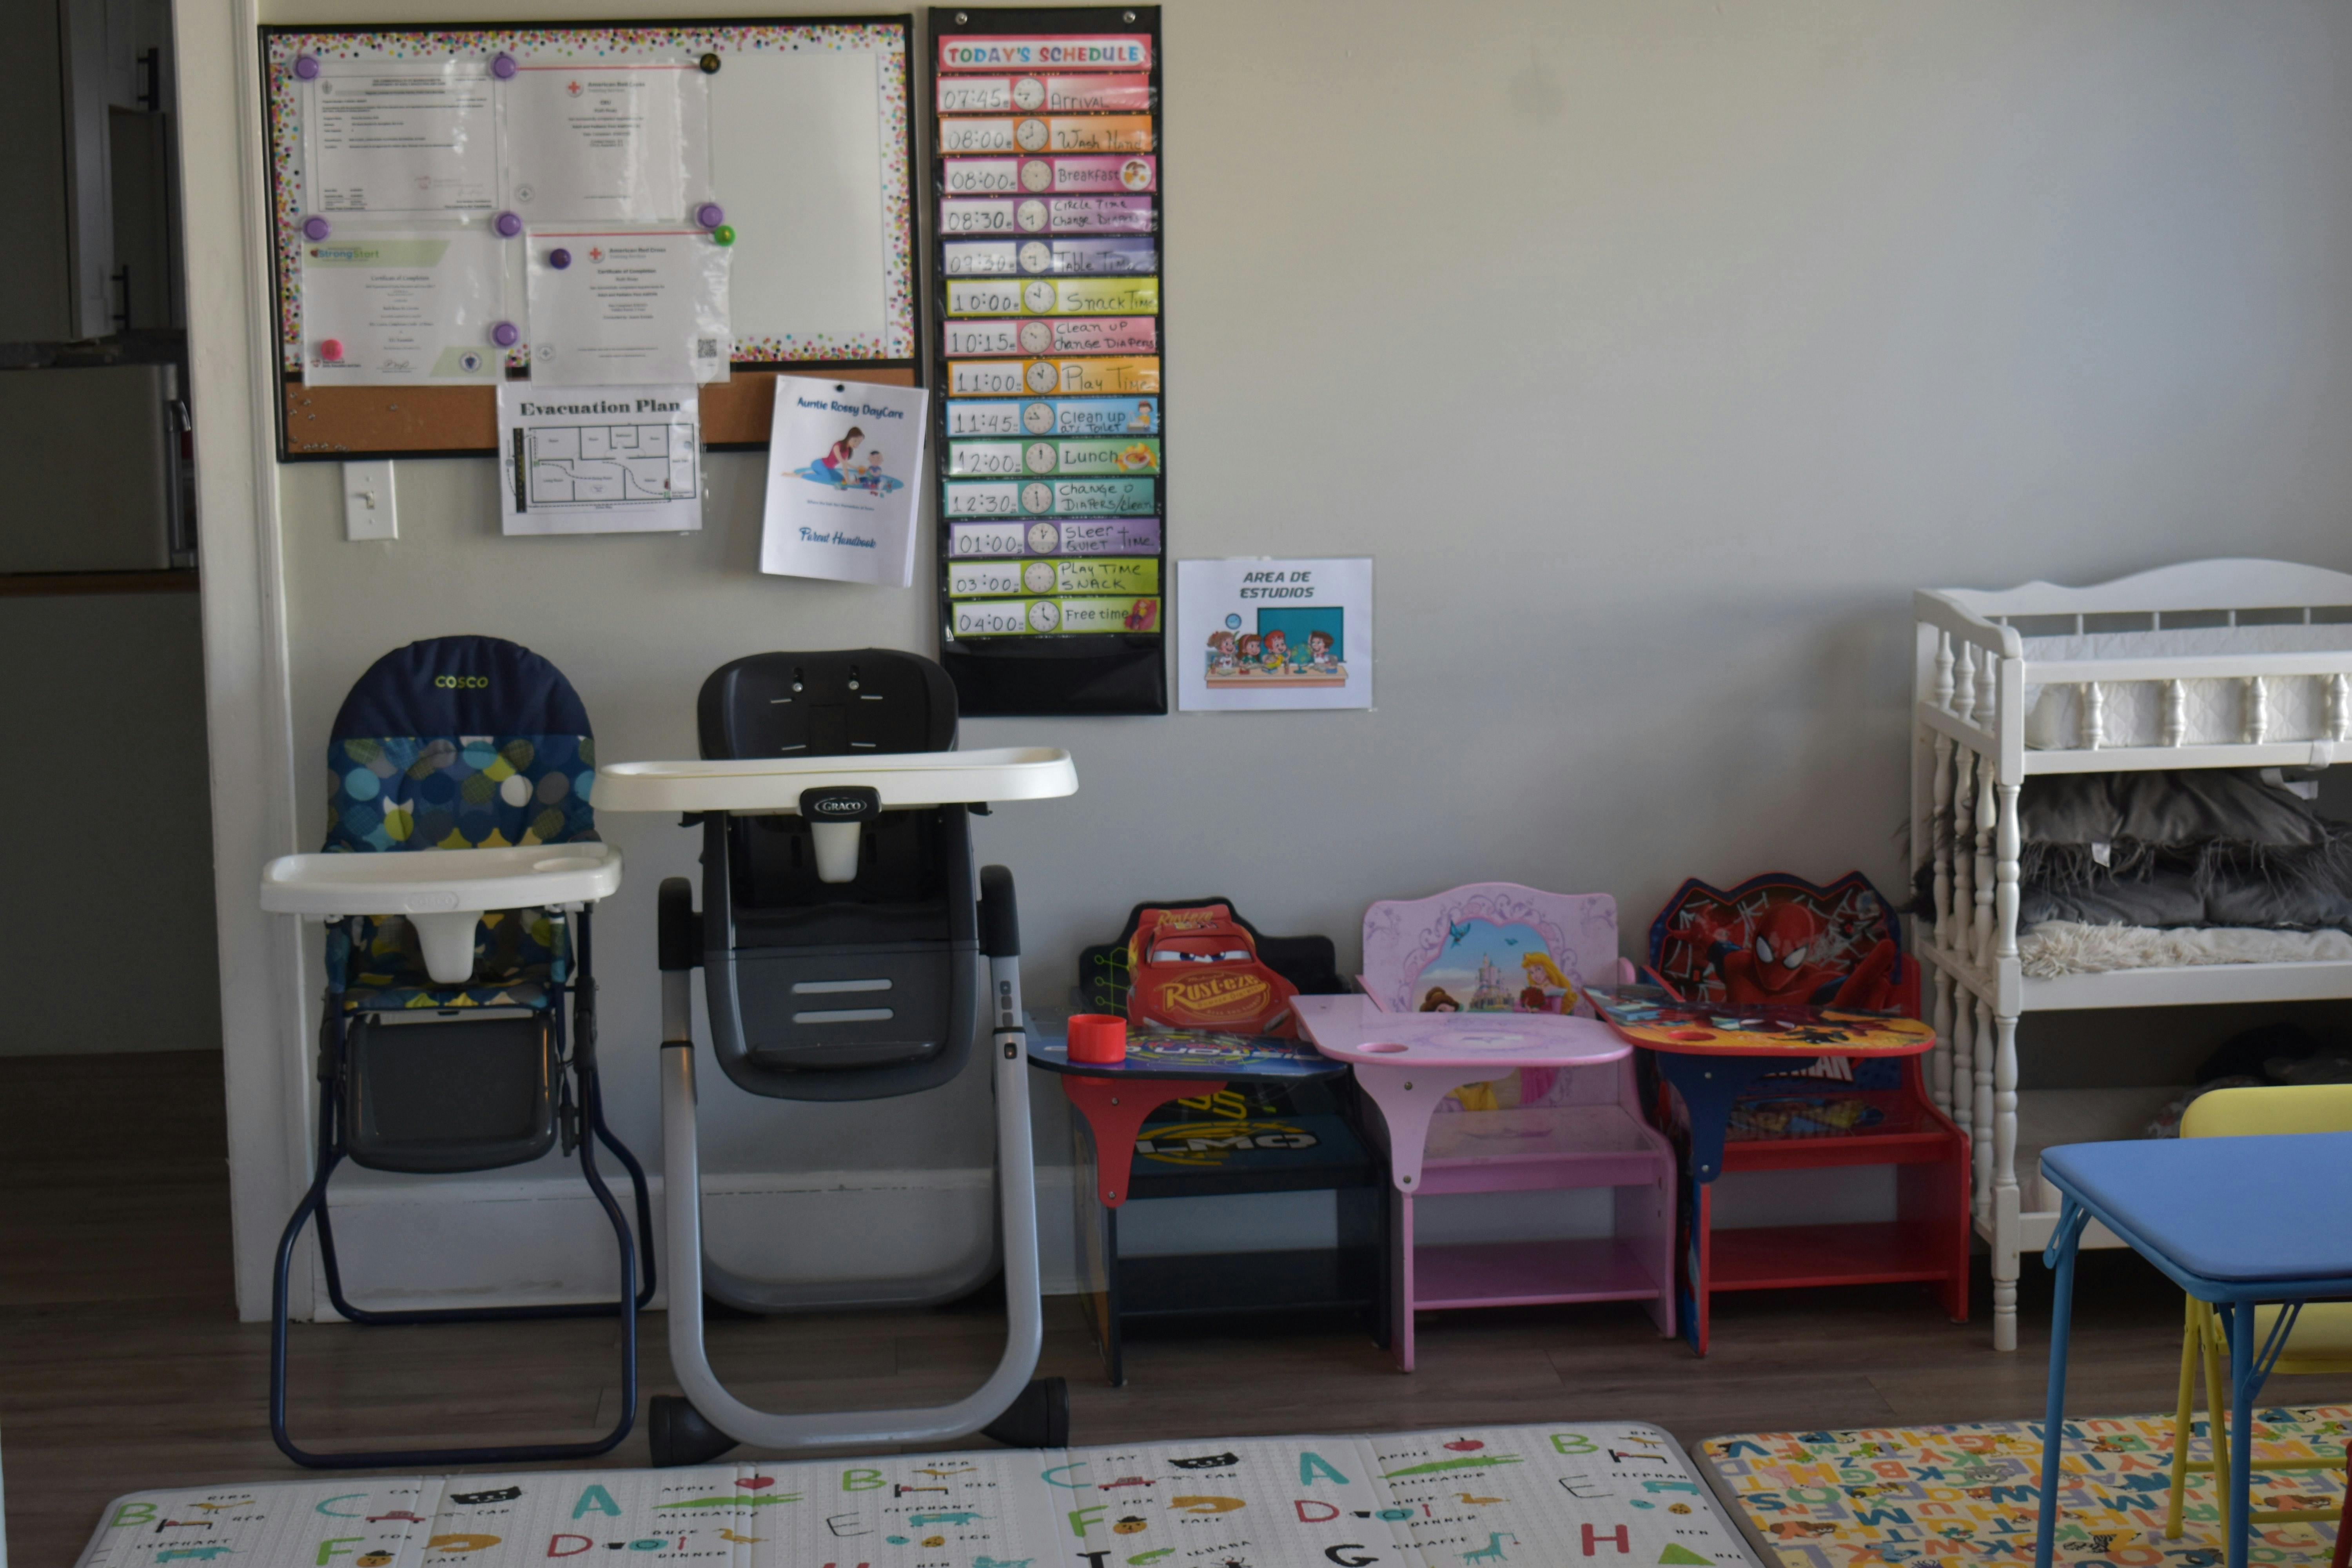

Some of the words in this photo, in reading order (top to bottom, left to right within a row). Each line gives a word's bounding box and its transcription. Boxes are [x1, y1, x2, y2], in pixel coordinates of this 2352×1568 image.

[948, 47, 1031, 63] TODAY'S
[1039, 45, 1139, 62] SCHEDULE
[944, 89, 1002, 109] 07:45
[949, 131, 1005, 150] 08:00
[952, 172, 1009, 190] 08:00
[1058, 168, 1121, 183] Breakfast
[949, 211, 1005, 231] 08:30
[954, 292, 1011, 311] 10:00
[1067, 293, 1125, 311] Snack
[1056, 322, 1102, 334] Clean
[953, 333, 1008, 353] 10:15
[957, 372, 1015, 392] 11:00
[1062, 365, 1103, 391] Play
[520, 402, 631, 416] Evacuation
[635, 399, 681, 413] Plan
[797, 397, 828, 410] Auntie
[831, 401, 860, 417] Rossy
[862, 405, 904, 419] DayCare
[954, 413, 1013, 433] 11:45
[1060, 411, 1103, 424] Clean
[1108, 411, 1126, 423] up
[959, 451, 1014, 473] 12:00
[1064, 450, 1118, 465] Lunch
[954, 494, 1011, 513] 12:30
[799, 527, 831, 543] Parent
[832, 531, 877, 549] Handbook
[960, 534, 1018, 554] 01:00
[956, 574, 1011, 592] 03:00
[1061, 579, 1126, 591] SNACK
[1243, 572, 1285, 583] AREA
[1289, 571, 1311, 583] DE
[1240, 587, 1315, 599] ESTUDIOS
[959, 613, 1018, 632] 04:00
[1065, 609, 1095, 620] Free
[1099, 608, 1129, 620] time
[434, 675, 489, 689] COSCO
[822, 801, 862, 811] GRACO
